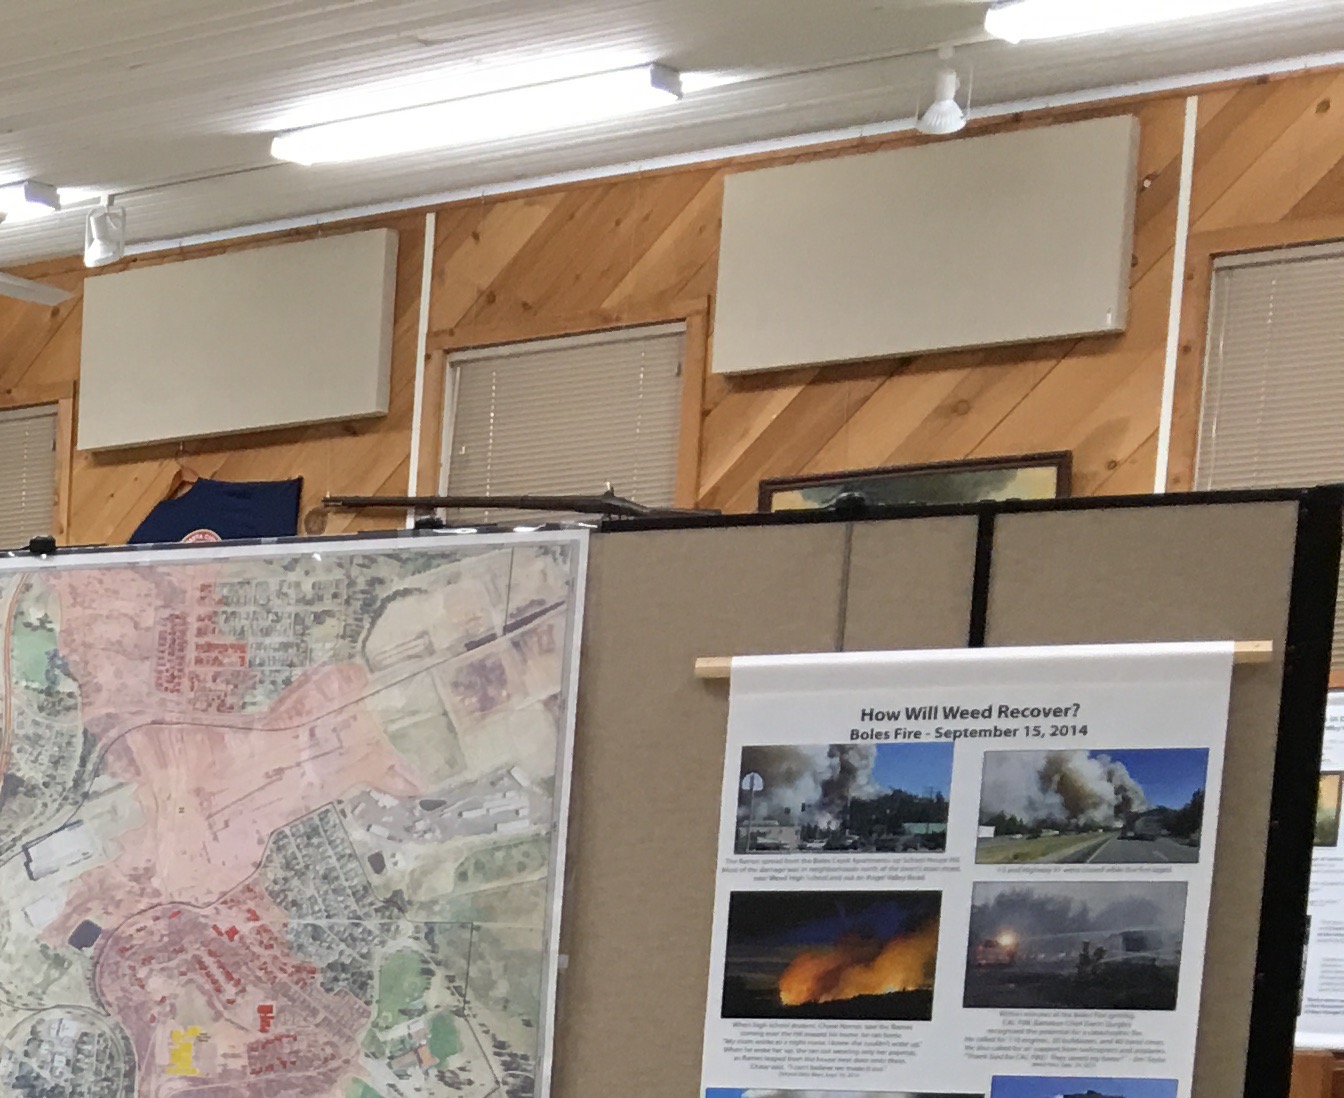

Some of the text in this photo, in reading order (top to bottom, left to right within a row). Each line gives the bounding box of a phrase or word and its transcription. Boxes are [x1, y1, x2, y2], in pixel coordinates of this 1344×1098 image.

[861, 703, 1080, 722] How Will Weed Recover?
[850, 728, 890, 741] Boles
[894, 728, 922, 740] Fire
[935, 726, 1019, 743] September
[1024, 725, 1045, 738] 15,
[1050, 725, 1088, 737] 2014
